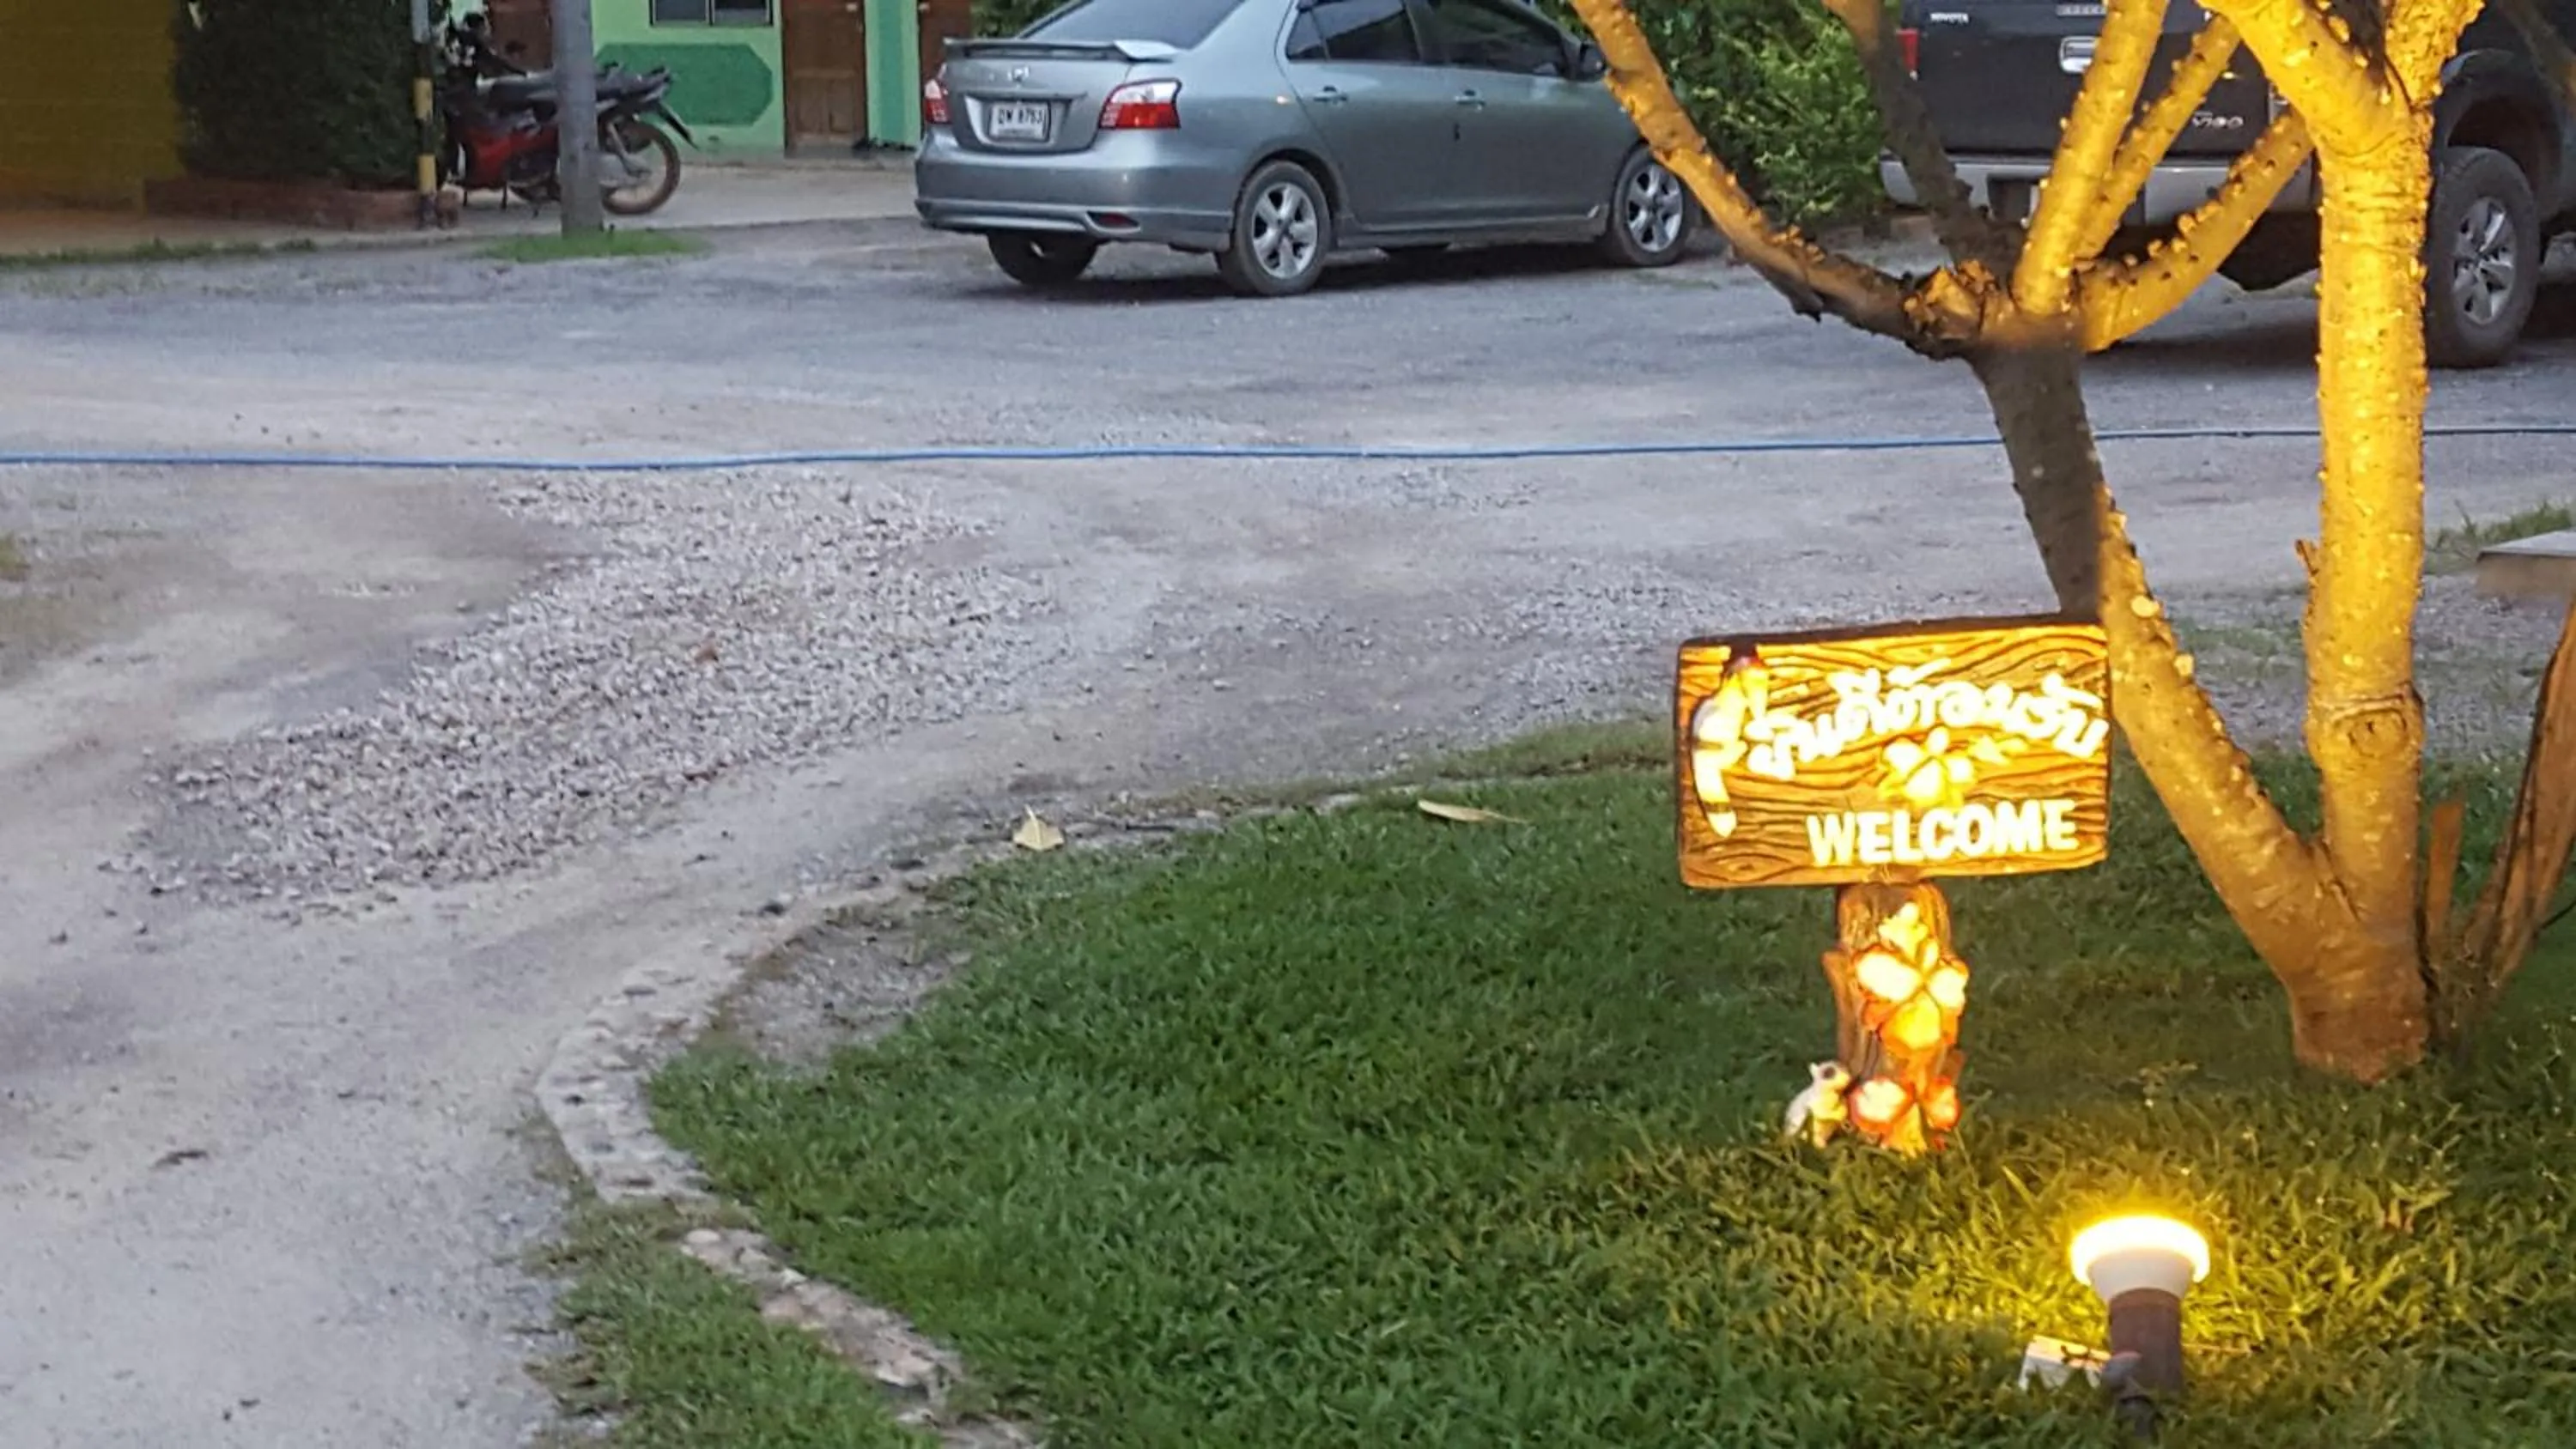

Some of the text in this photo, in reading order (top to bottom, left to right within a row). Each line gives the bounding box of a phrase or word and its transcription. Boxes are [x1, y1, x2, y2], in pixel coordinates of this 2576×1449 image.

[1744, 658, 2110, 780] ยินดีต้อนรับ
[1806, 798, 2079, 868] WELCOME
